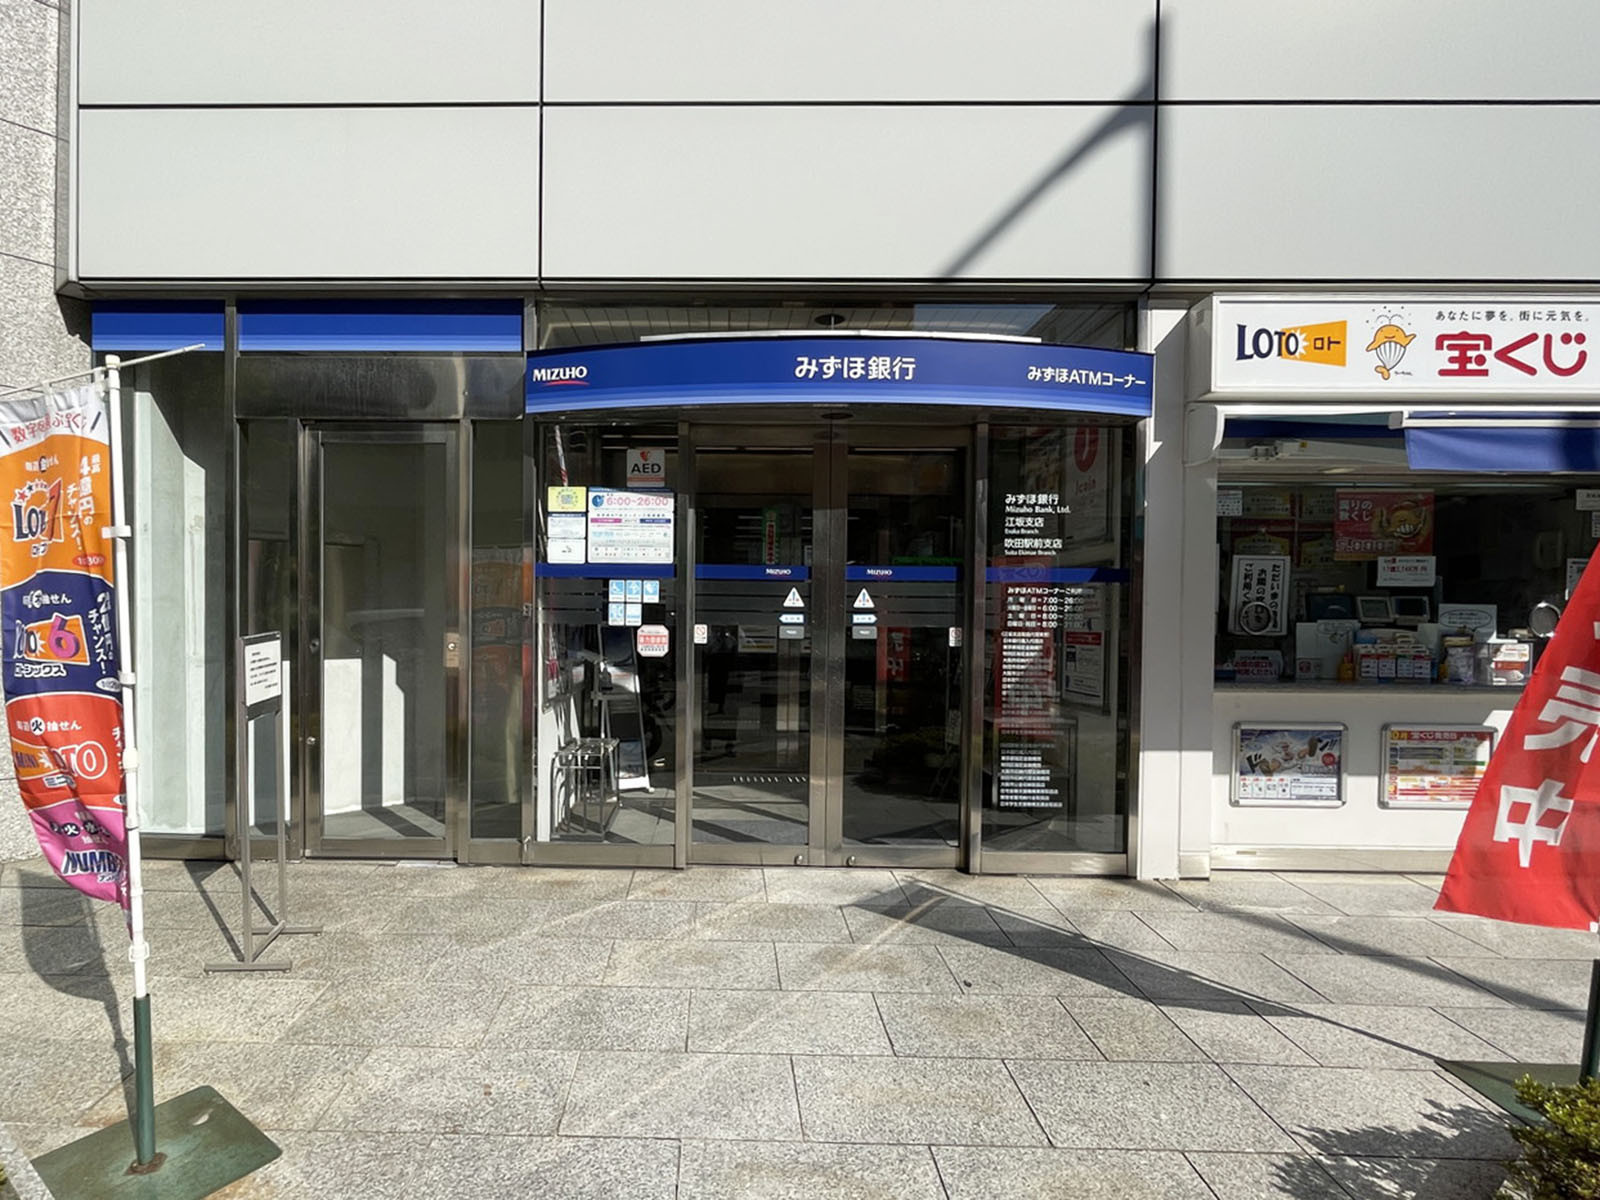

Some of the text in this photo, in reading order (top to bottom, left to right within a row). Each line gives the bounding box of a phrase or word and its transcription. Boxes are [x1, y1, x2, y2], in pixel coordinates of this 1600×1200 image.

[1435, 310, 1589, 322] あなたに夢を。街に元気を。
[1236, 323, 1299, 361] LOTO
[1435, 331, 1588, 377] 宝くじ
[532, 366, 588, 382] MIZUHO
[795, 356, 916, 380] みずほ銀行
[1027, 366, 1146, 388] みずほATMコーナー
[631, 463, 662, 474] AED
[1005, 494, 1059, 504] みずほ銀行
[1005, 517, 1045, 527] 江坂支店
[1004, 538, 1062, 549] 吹田駅前支店
